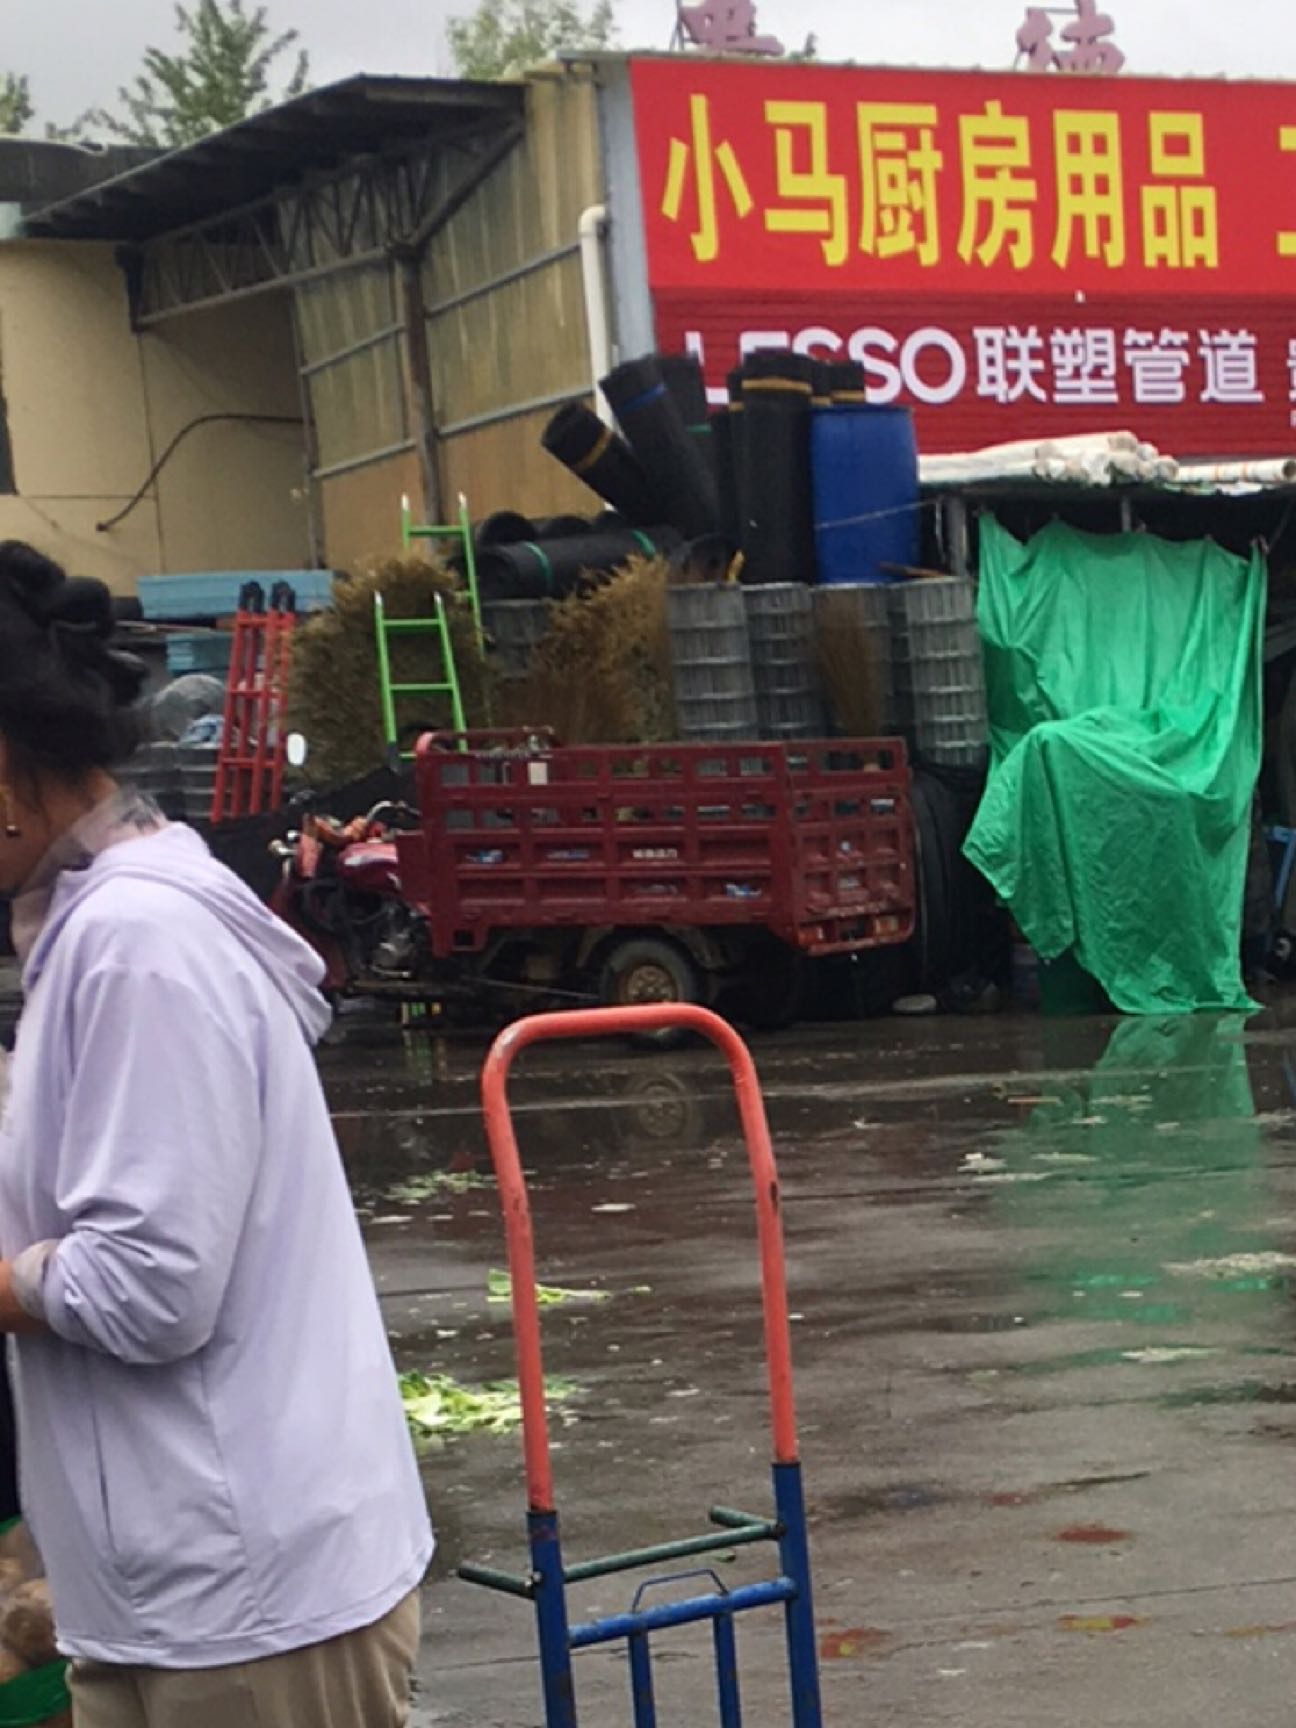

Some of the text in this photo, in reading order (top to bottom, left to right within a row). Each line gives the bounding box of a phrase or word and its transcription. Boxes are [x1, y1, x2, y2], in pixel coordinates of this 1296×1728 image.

[662, 95, 1219, 268] 小马厨房用品
[973, 325, 1265, 404] 联塑管道
